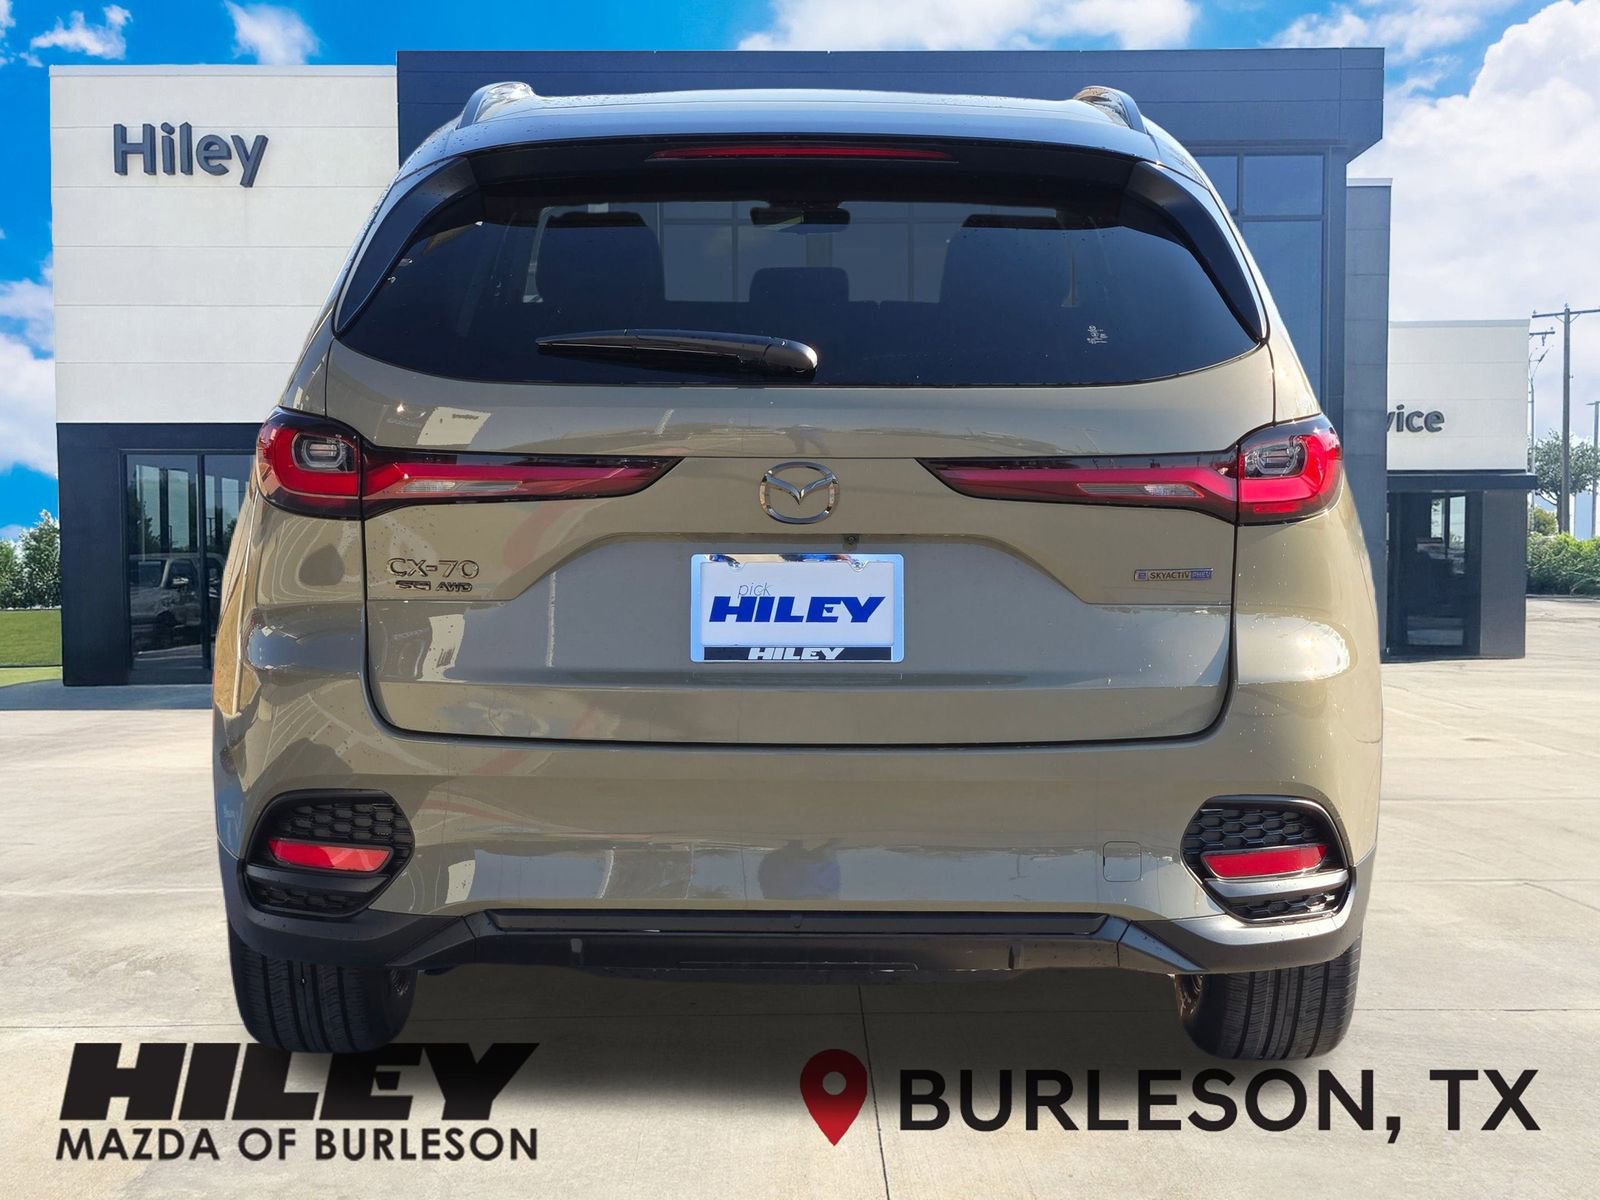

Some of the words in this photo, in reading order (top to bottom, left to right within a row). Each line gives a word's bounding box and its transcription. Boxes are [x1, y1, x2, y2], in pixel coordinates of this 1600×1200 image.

[113, 122, 269, 188] Hiley
[387, 557, 480, 579] CX-70
[1150, 571, 1190, 580] SKYACTIV
[436, 582, 473, 592] AWD
[737, 582, 773, 598] pick
[709, 596, 887, 622] HILEY
[747, 647, 845, 660] HILEY
